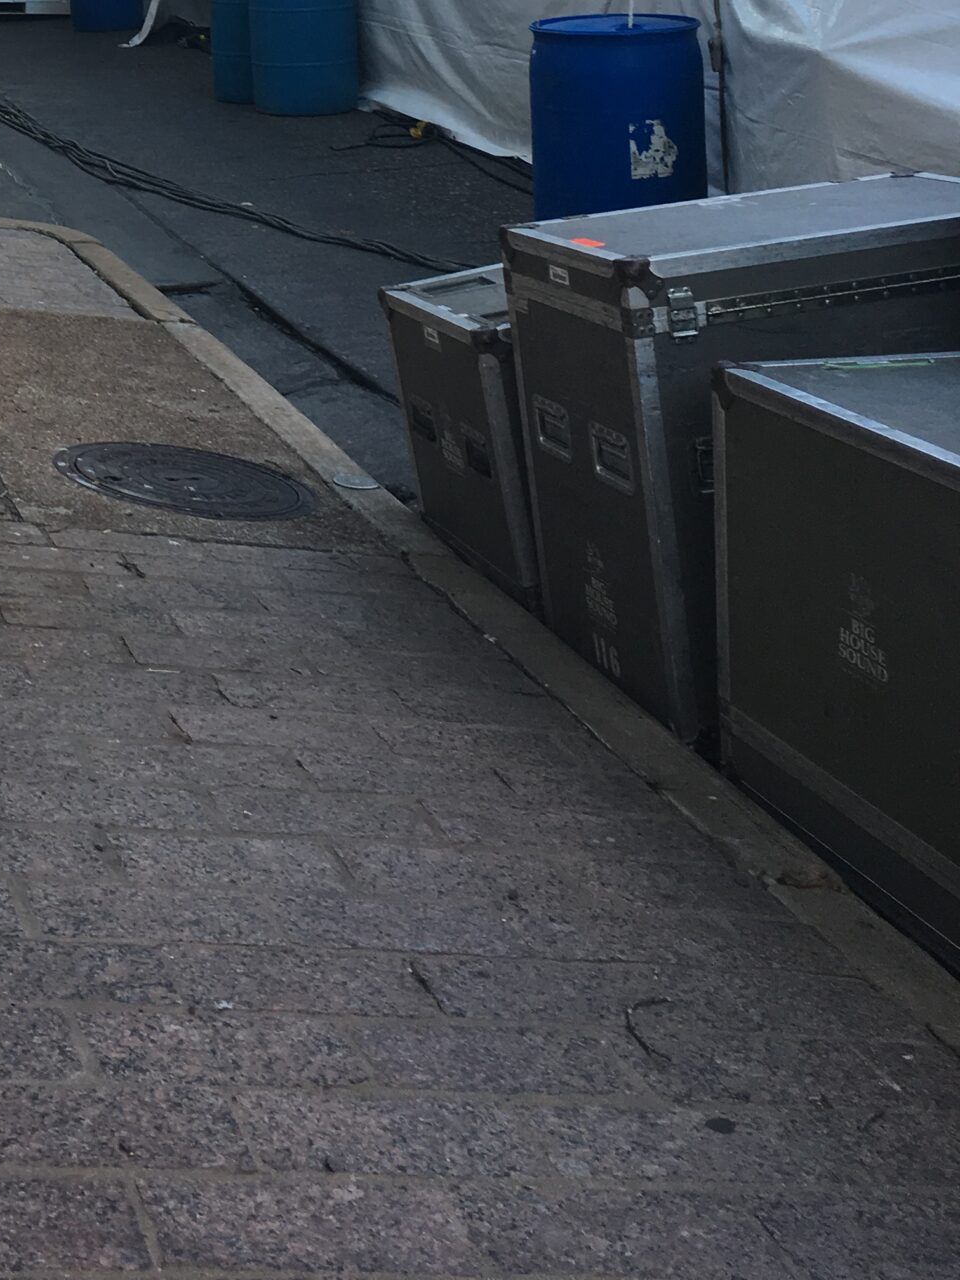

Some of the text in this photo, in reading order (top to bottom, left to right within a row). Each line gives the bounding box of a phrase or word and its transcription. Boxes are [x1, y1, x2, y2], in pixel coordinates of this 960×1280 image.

[840, 627, 887, 666] HOUSE
[851, 619, 875, 644] BIG
[839, 643, 888, 682] SOUND
